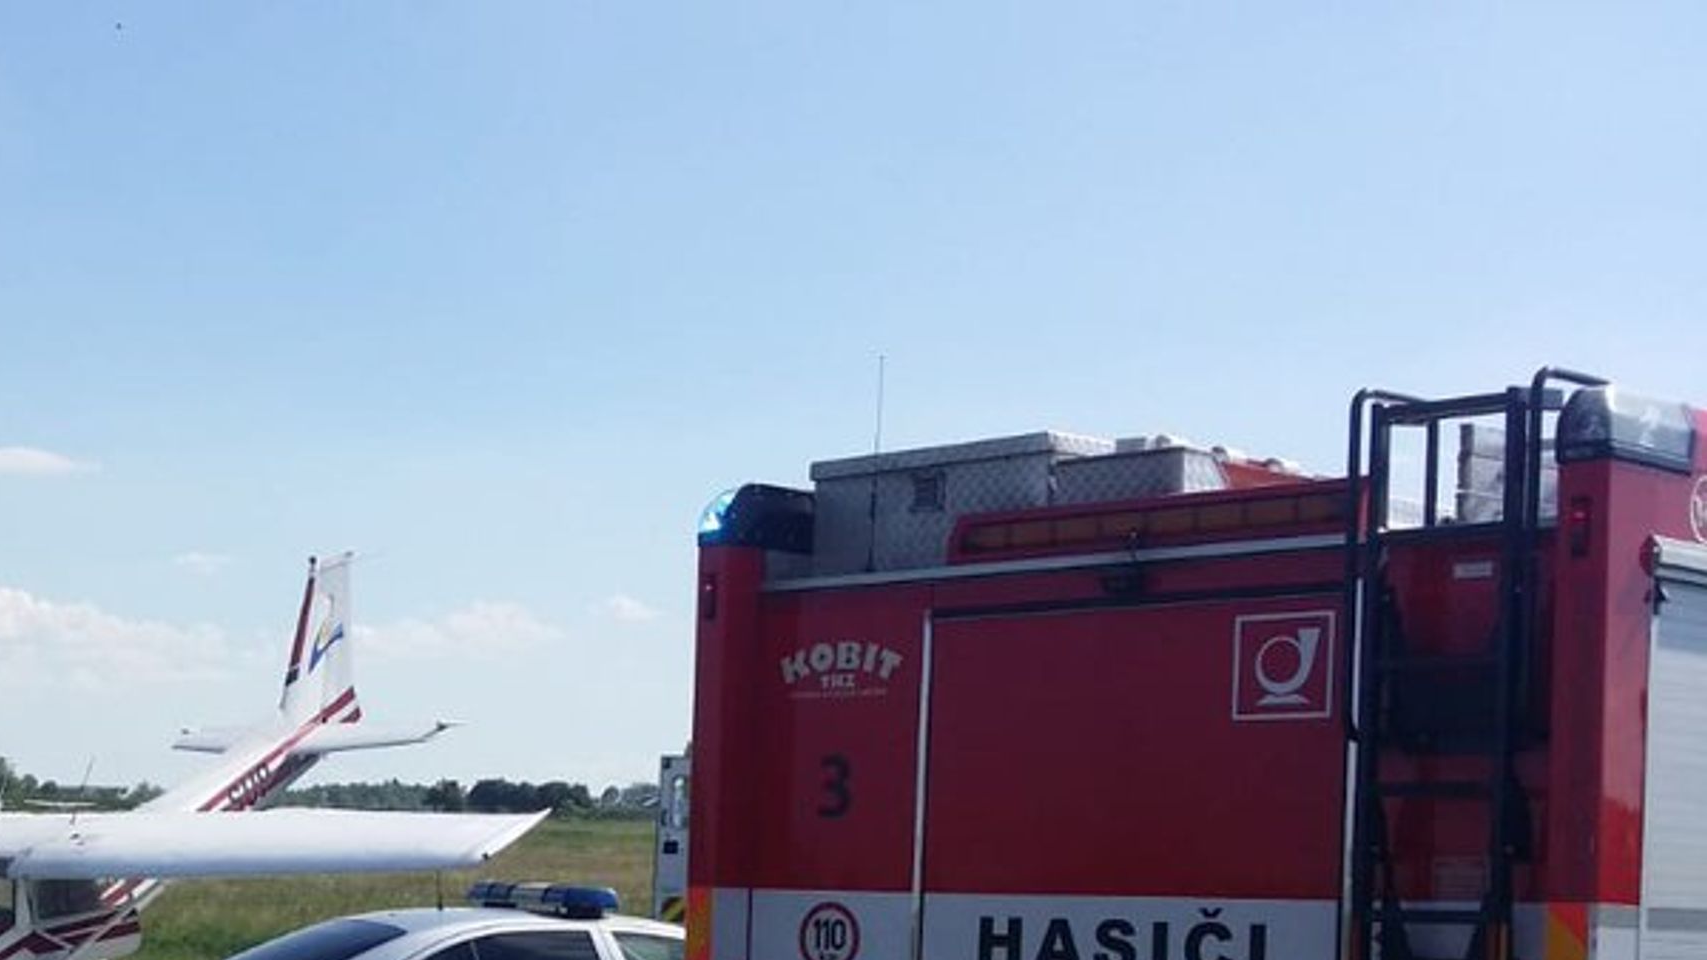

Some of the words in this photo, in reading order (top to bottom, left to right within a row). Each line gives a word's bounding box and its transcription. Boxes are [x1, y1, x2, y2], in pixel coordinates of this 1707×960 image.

[780, 642, 903, 684] KOBIT
[818, 753, 850, 818] 3
[814, 918, 846, 950] 110
